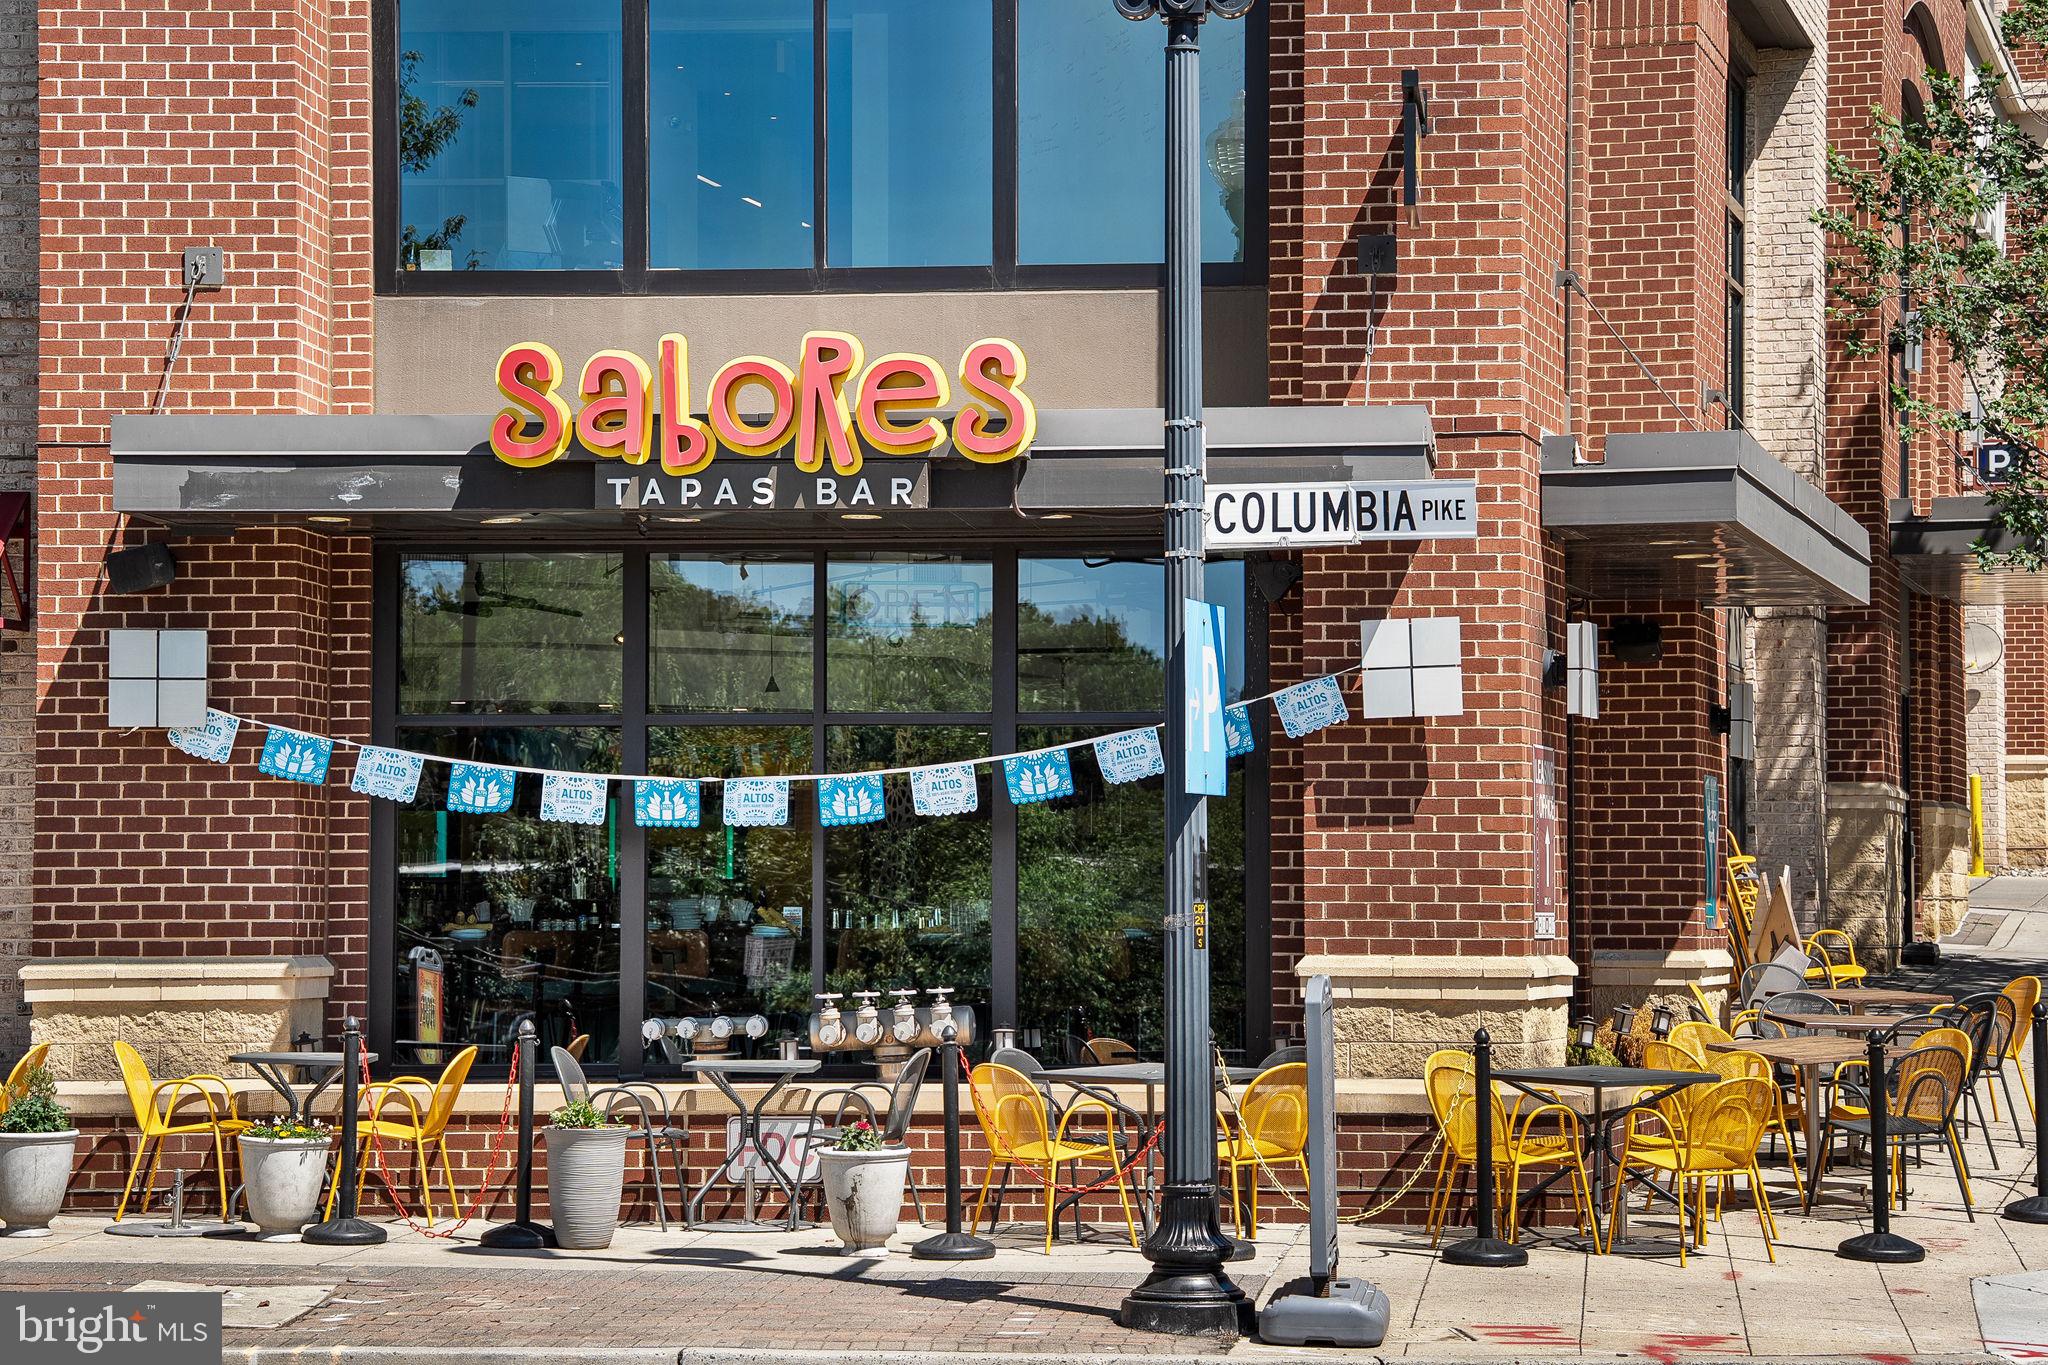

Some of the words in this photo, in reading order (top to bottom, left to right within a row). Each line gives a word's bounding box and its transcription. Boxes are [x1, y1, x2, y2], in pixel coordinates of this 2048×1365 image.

[1989, 450, 2011, 477] P
[607, 478, 775, 505] TAPAS
[816, 478, 913, 505] BAR
[1214, 490, 1417, 534] COLUMBIA
[1422, 499, 1467, 521] PIKE
[1297, 692, 1328, 711] ALTOS
[1116, 744, 1147, 760] ALTOS
[375, 763, 407, 777] ALTOS
[931, 778, 962, 791] ALTOS
[561, 788, 592, 800] ALTOS
[743, 793, 774, 803] ALTOS
[1195, 916, 1204, 925] 24
